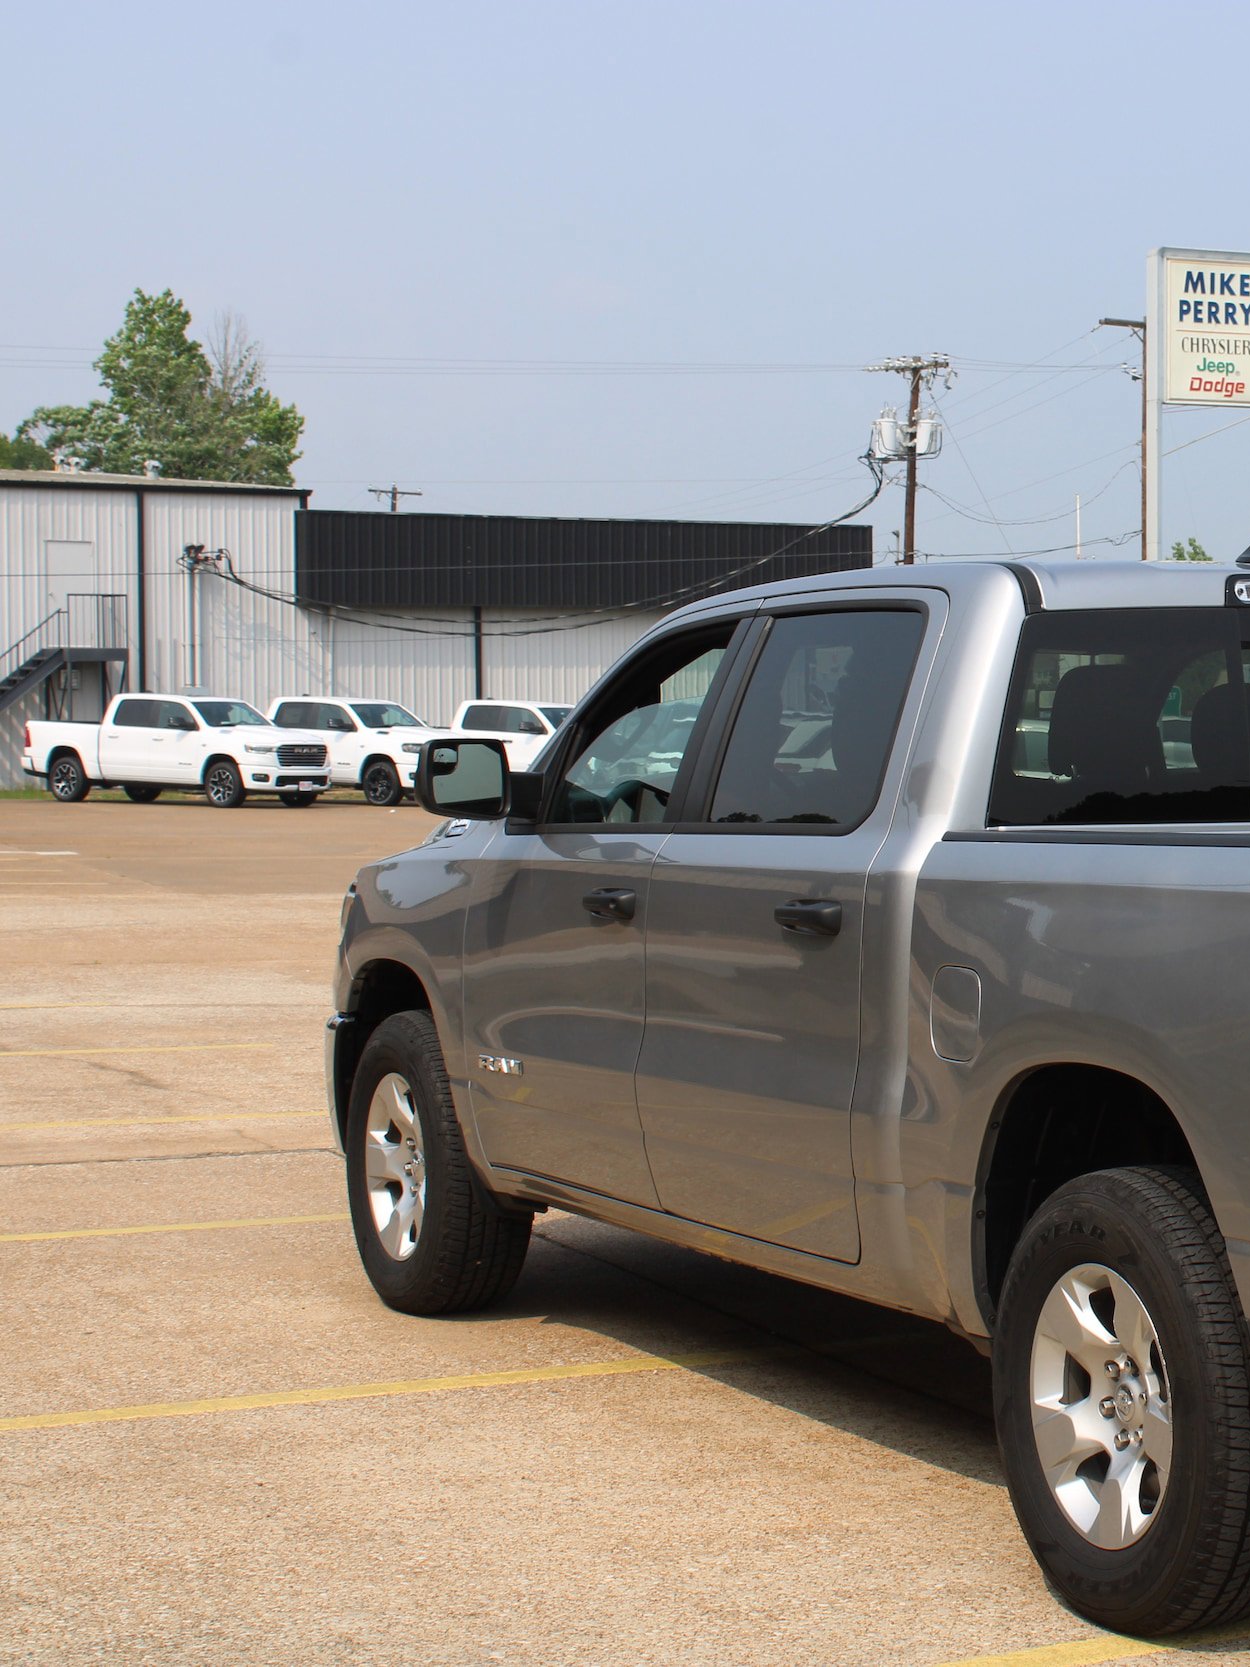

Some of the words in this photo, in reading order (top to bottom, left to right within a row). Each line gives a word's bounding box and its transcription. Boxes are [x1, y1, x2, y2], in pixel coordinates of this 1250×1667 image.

[1184, 271, 1250, 297] MIKE
[1196, 357, 1236, 376] Jeep
[1189, 377, 1246, 398] Dodge
[479, 1054, 524, 1075] RAM
